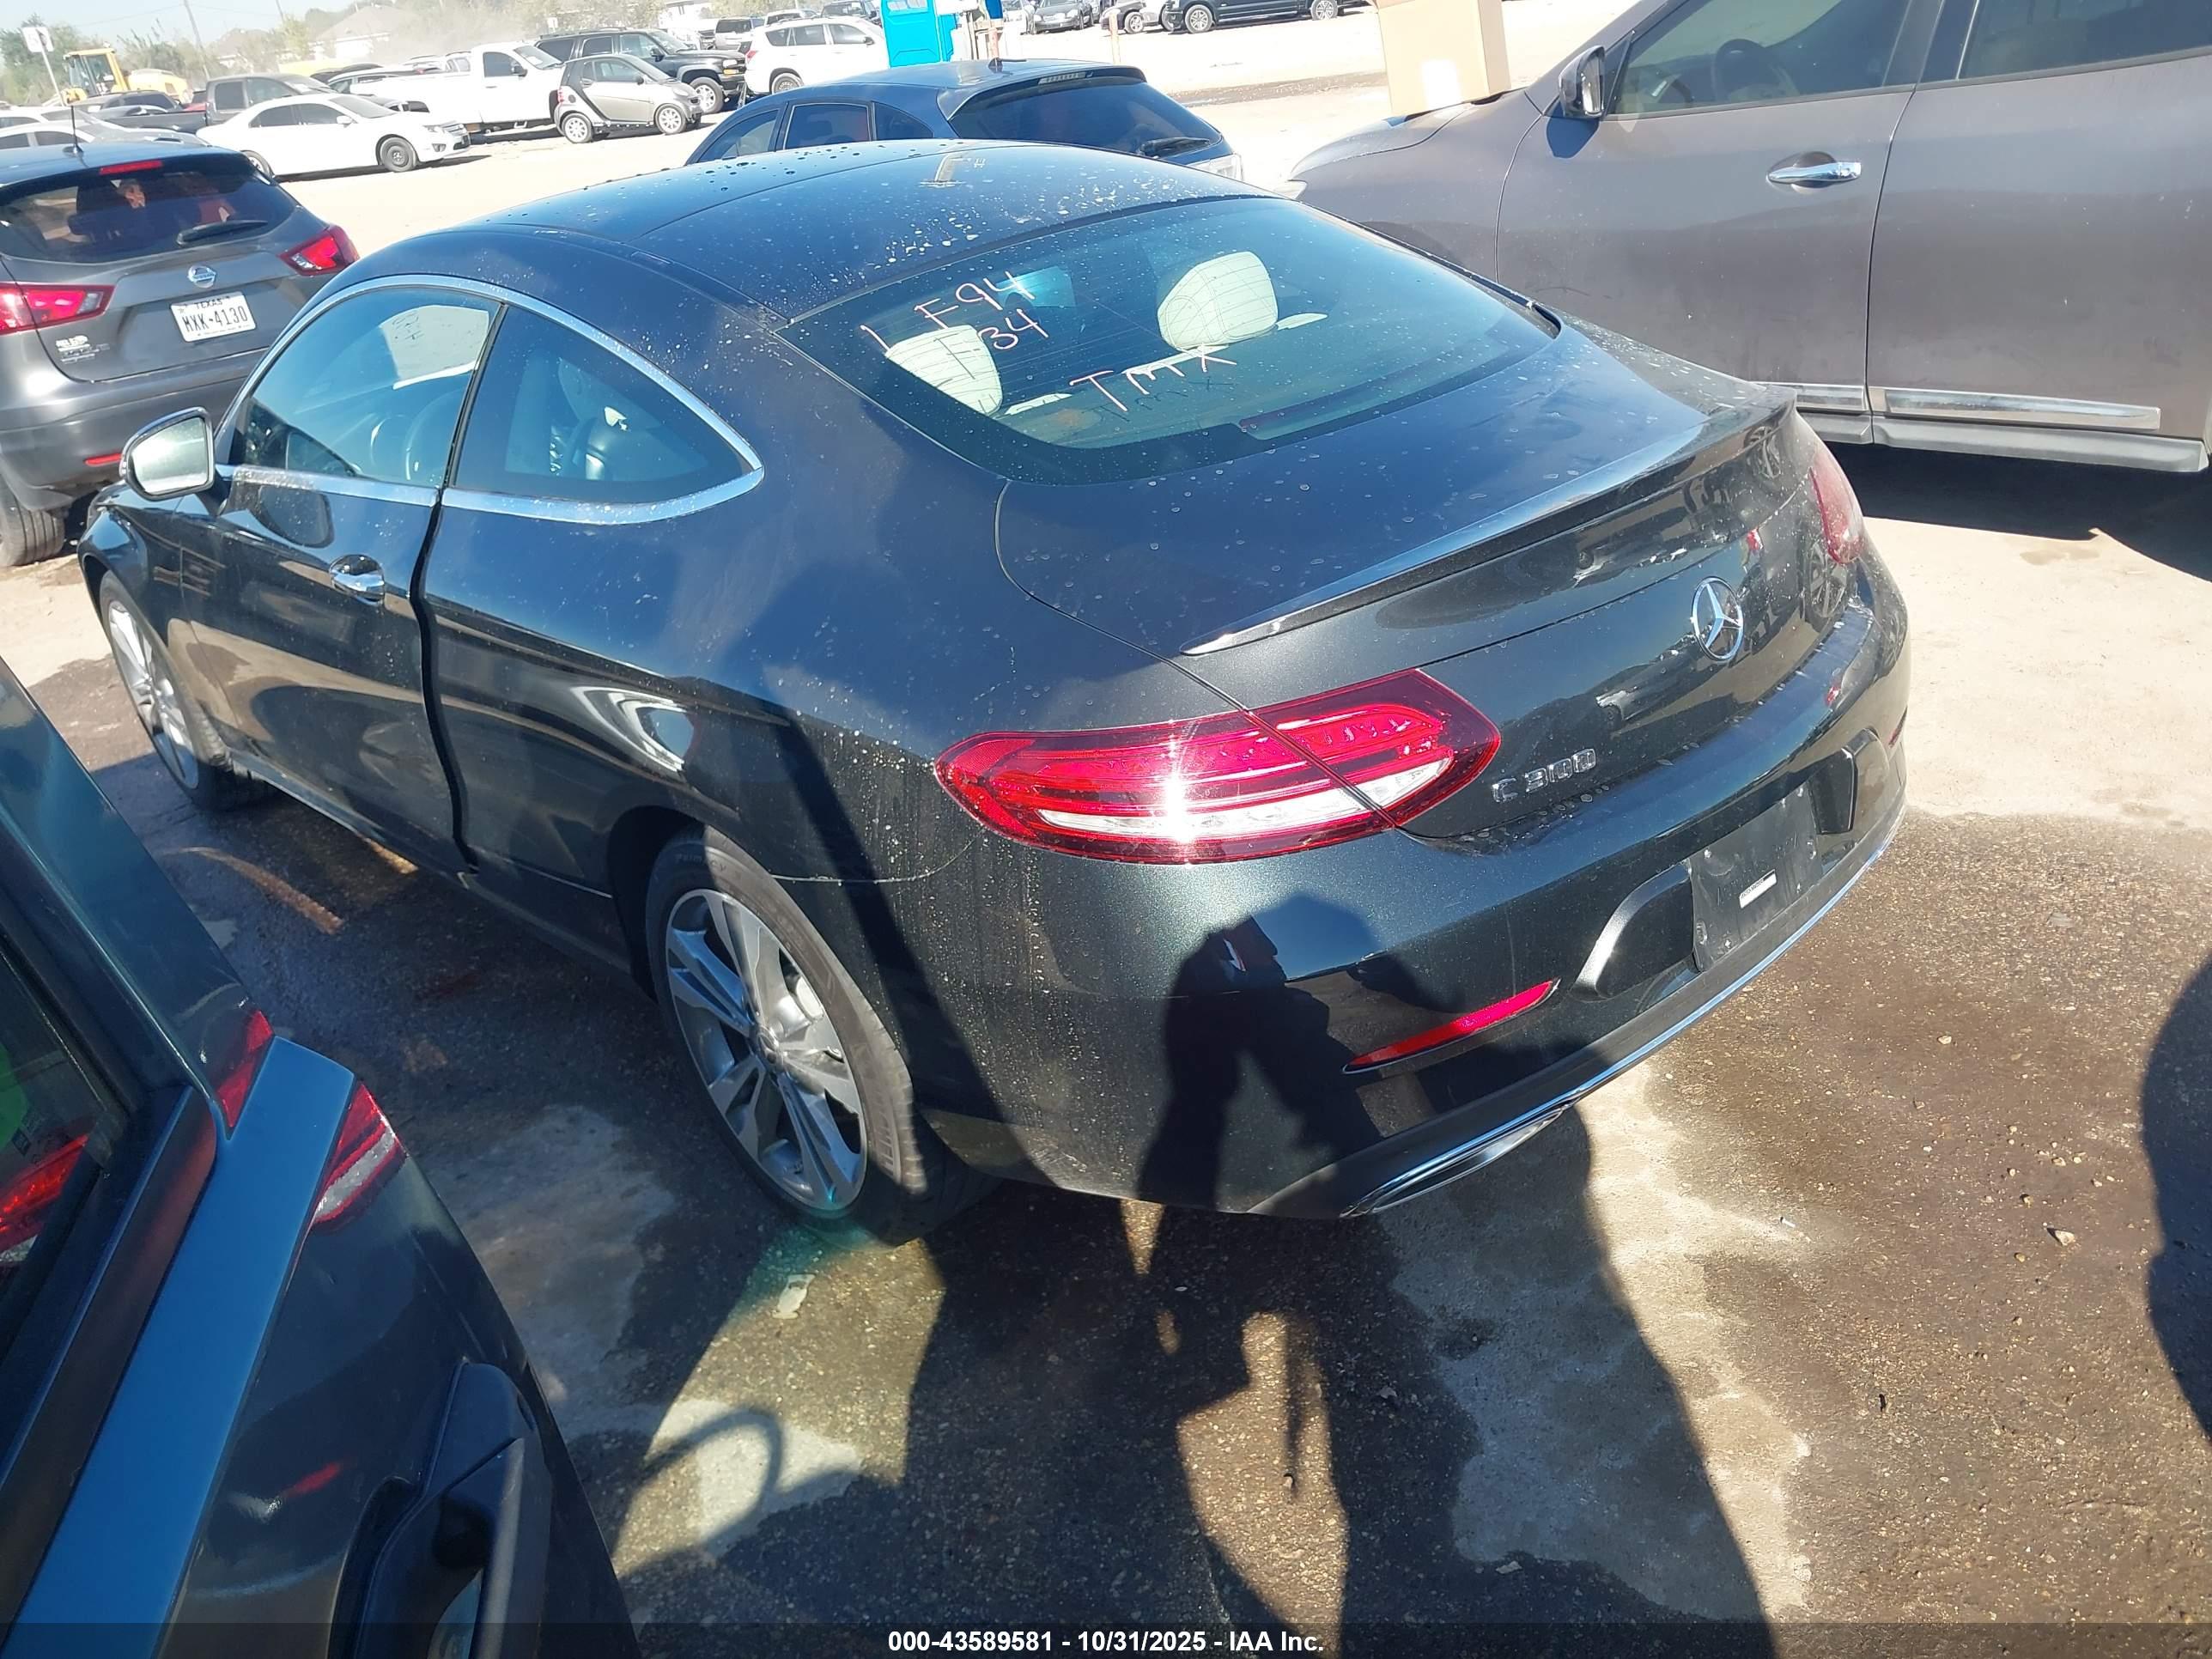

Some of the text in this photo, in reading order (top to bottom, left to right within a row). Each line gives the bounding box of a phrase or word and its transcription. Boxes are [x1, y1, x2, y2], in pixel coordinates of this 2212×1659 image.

[194, 298, 223, 310] TEXAS
[1492, 748, 1596, 803] C 300
